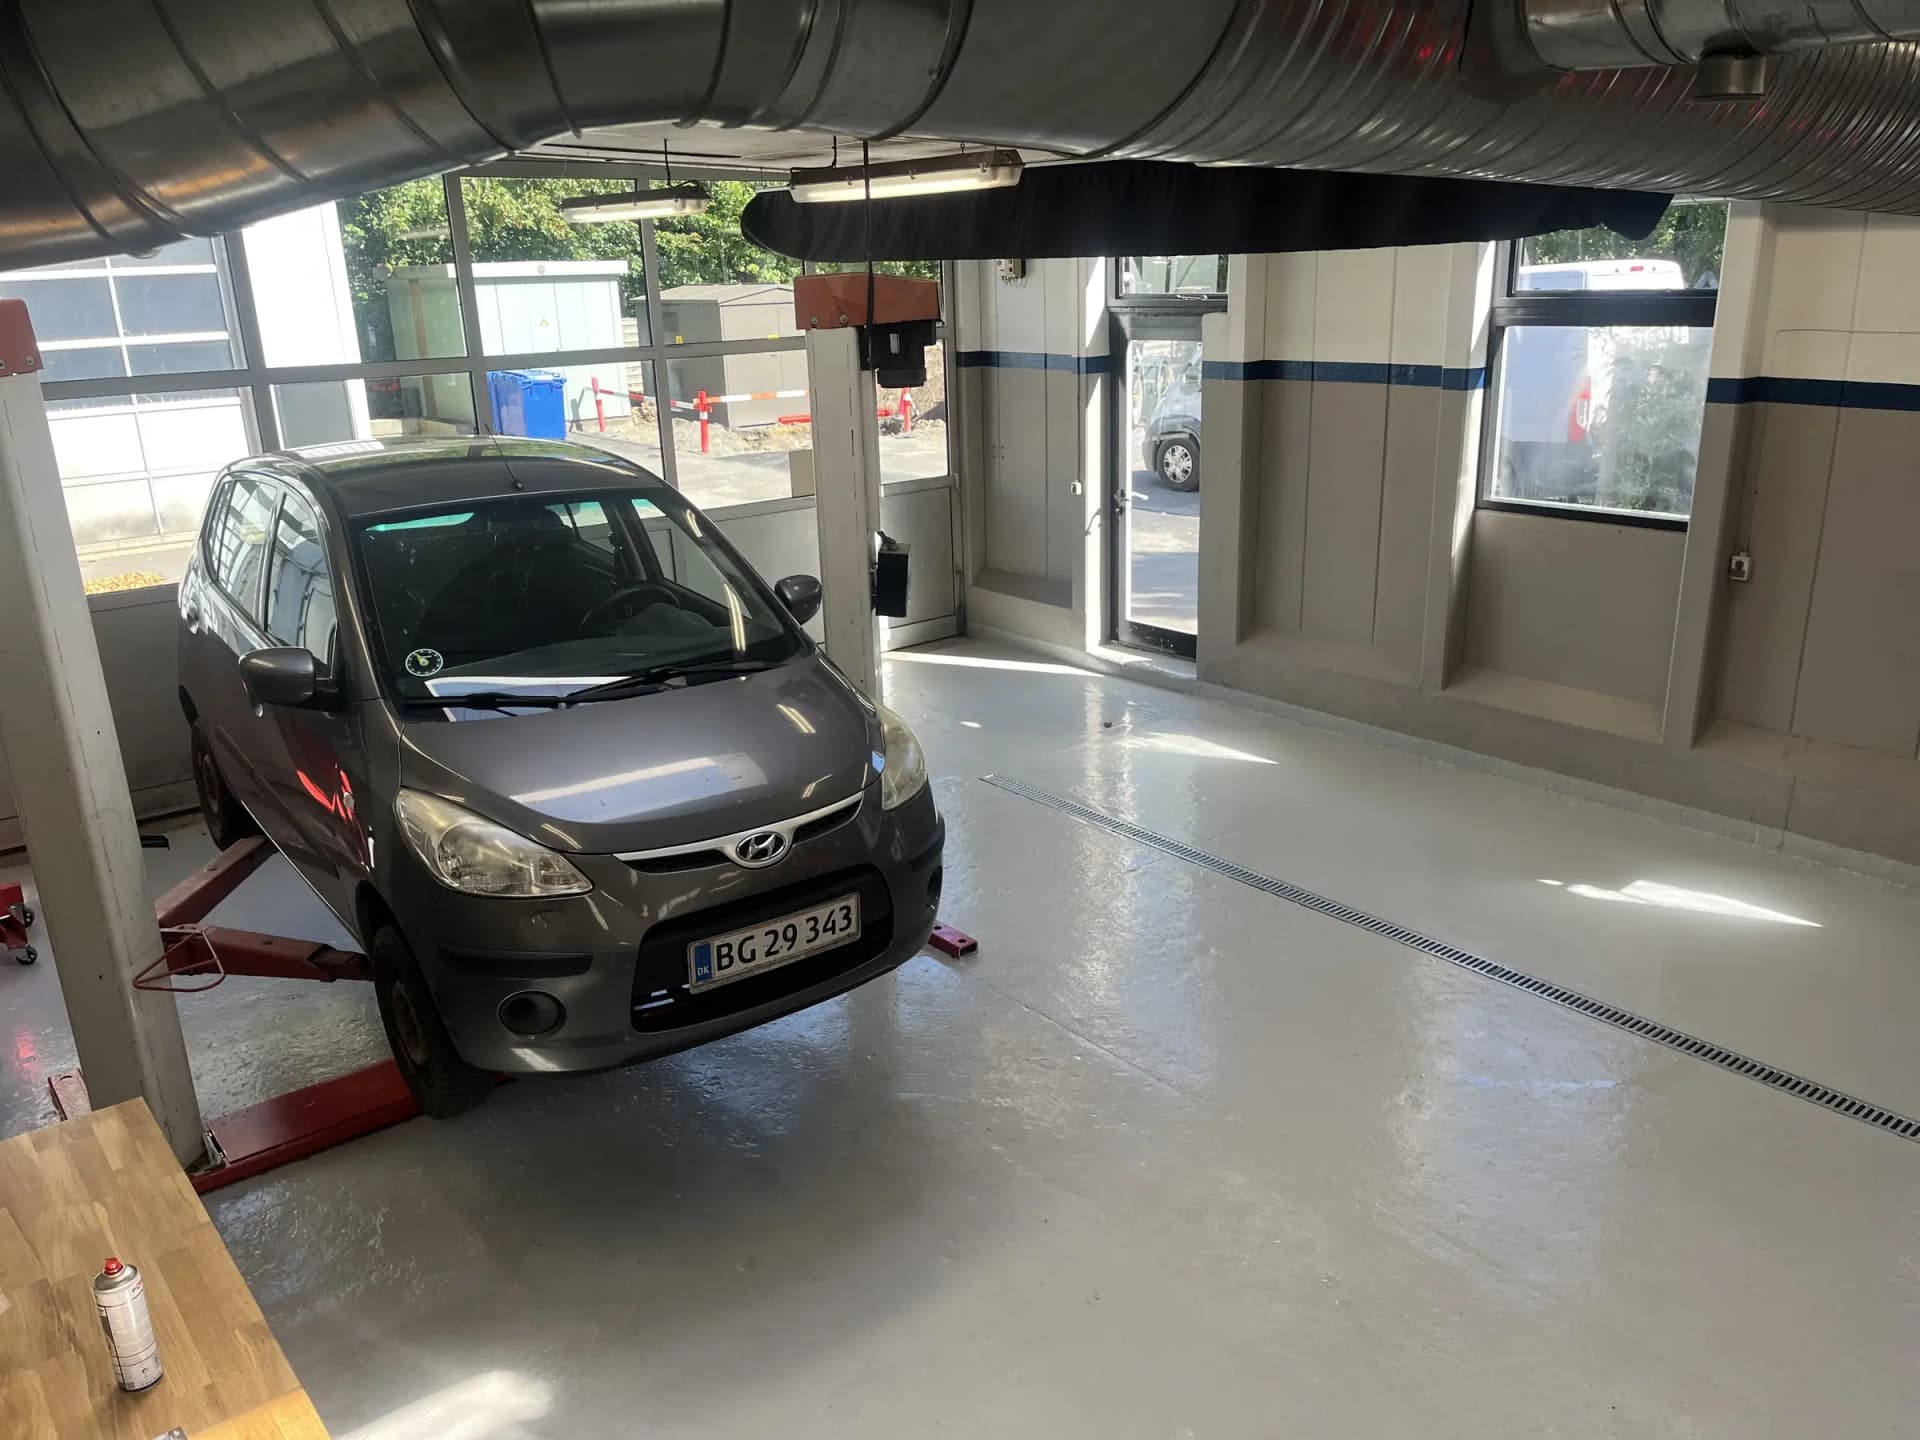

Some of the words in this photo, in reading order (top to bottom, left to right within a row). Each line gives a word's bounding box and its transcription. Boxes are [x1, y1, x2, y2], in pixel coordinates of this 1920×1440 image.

[716, 935, 756, 971] BG
[764, 923, 798, 957] 29
[805, 905, 852, 944] 343
[697, 965, 710, 976] DK
